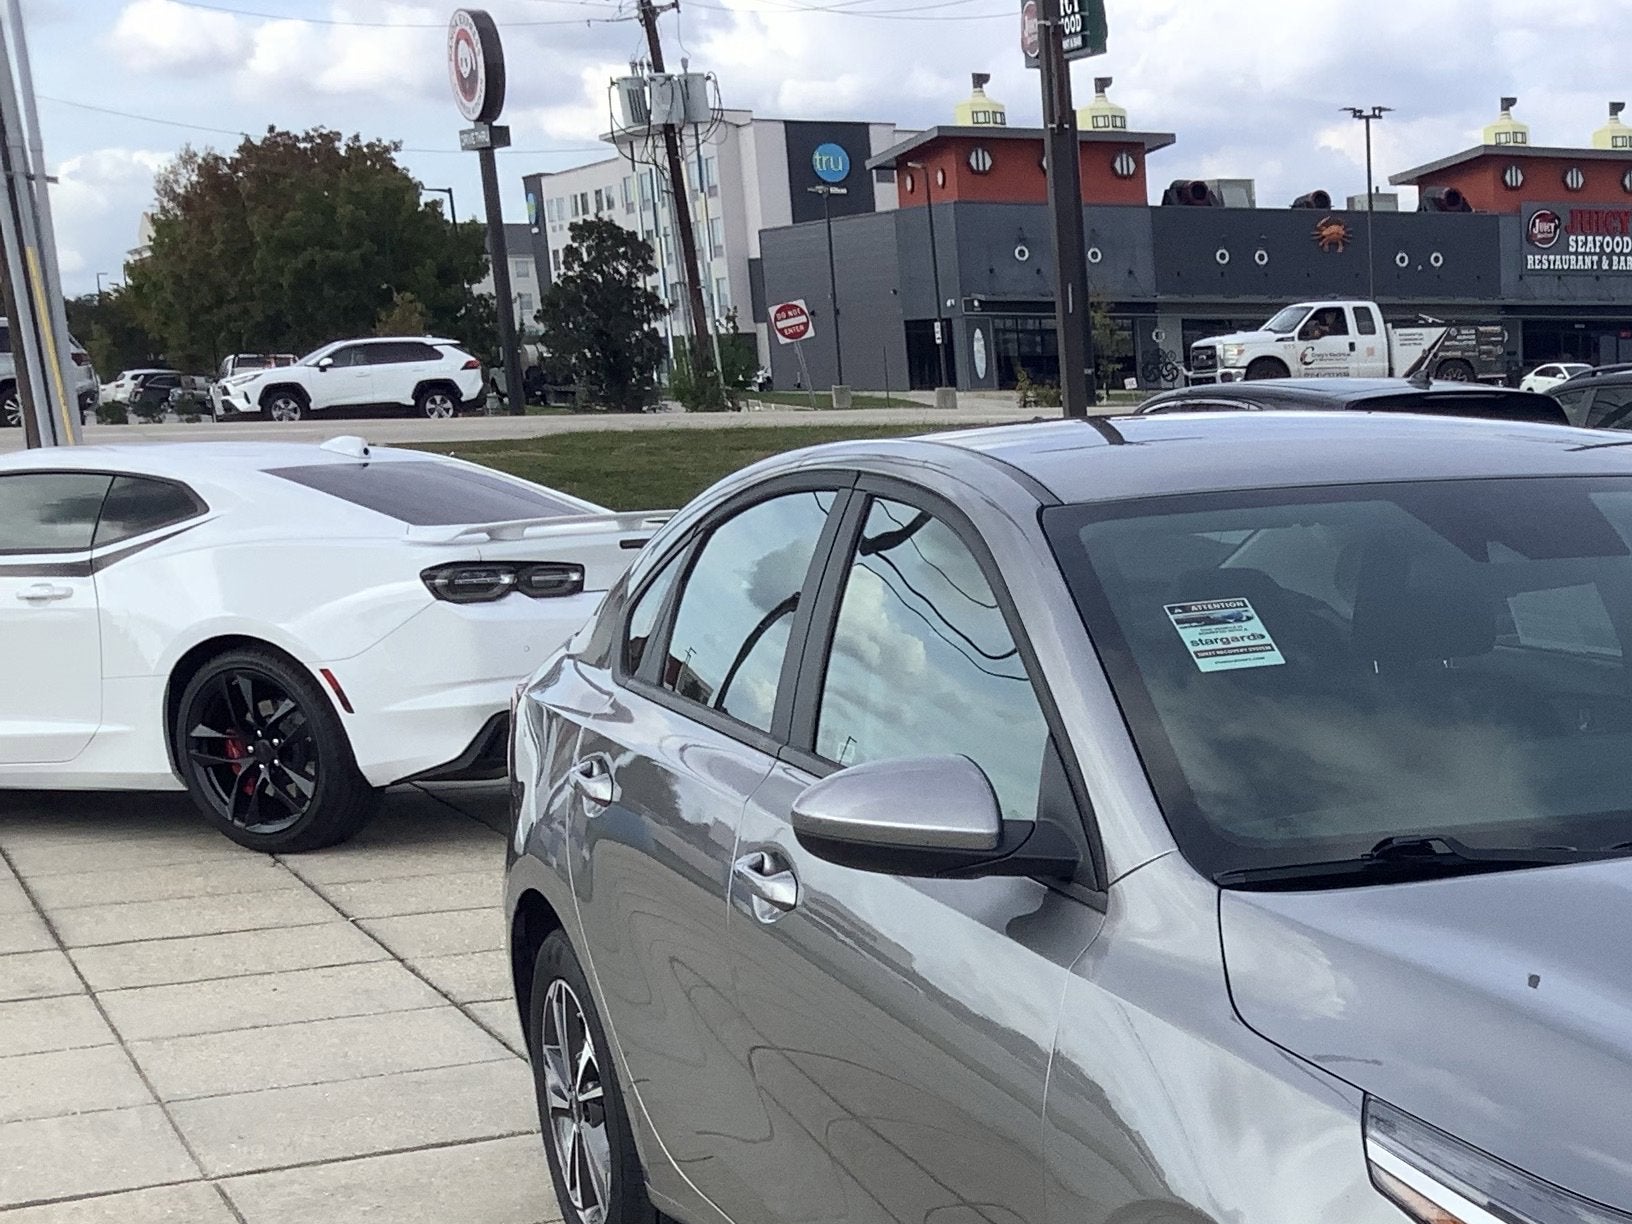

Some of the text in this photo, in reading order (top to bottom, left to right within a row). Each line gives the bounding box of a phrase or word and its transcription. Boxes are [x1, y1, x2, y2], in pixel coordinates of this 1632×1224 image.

[814, 150, 842, 171] tru
[1565, 209, 1632, 234] JUICY
[1568, 236, 1632, 253] SEAFOOD
[1527, 255, 1598, 269] RESTAURANT
[1601, 256, 1609, 269] &
[776, 307, 801, 320] DO NOT
[783, 325, 805, 336] ENTER
[1191, 601, 1244, 611] ATTENTION
